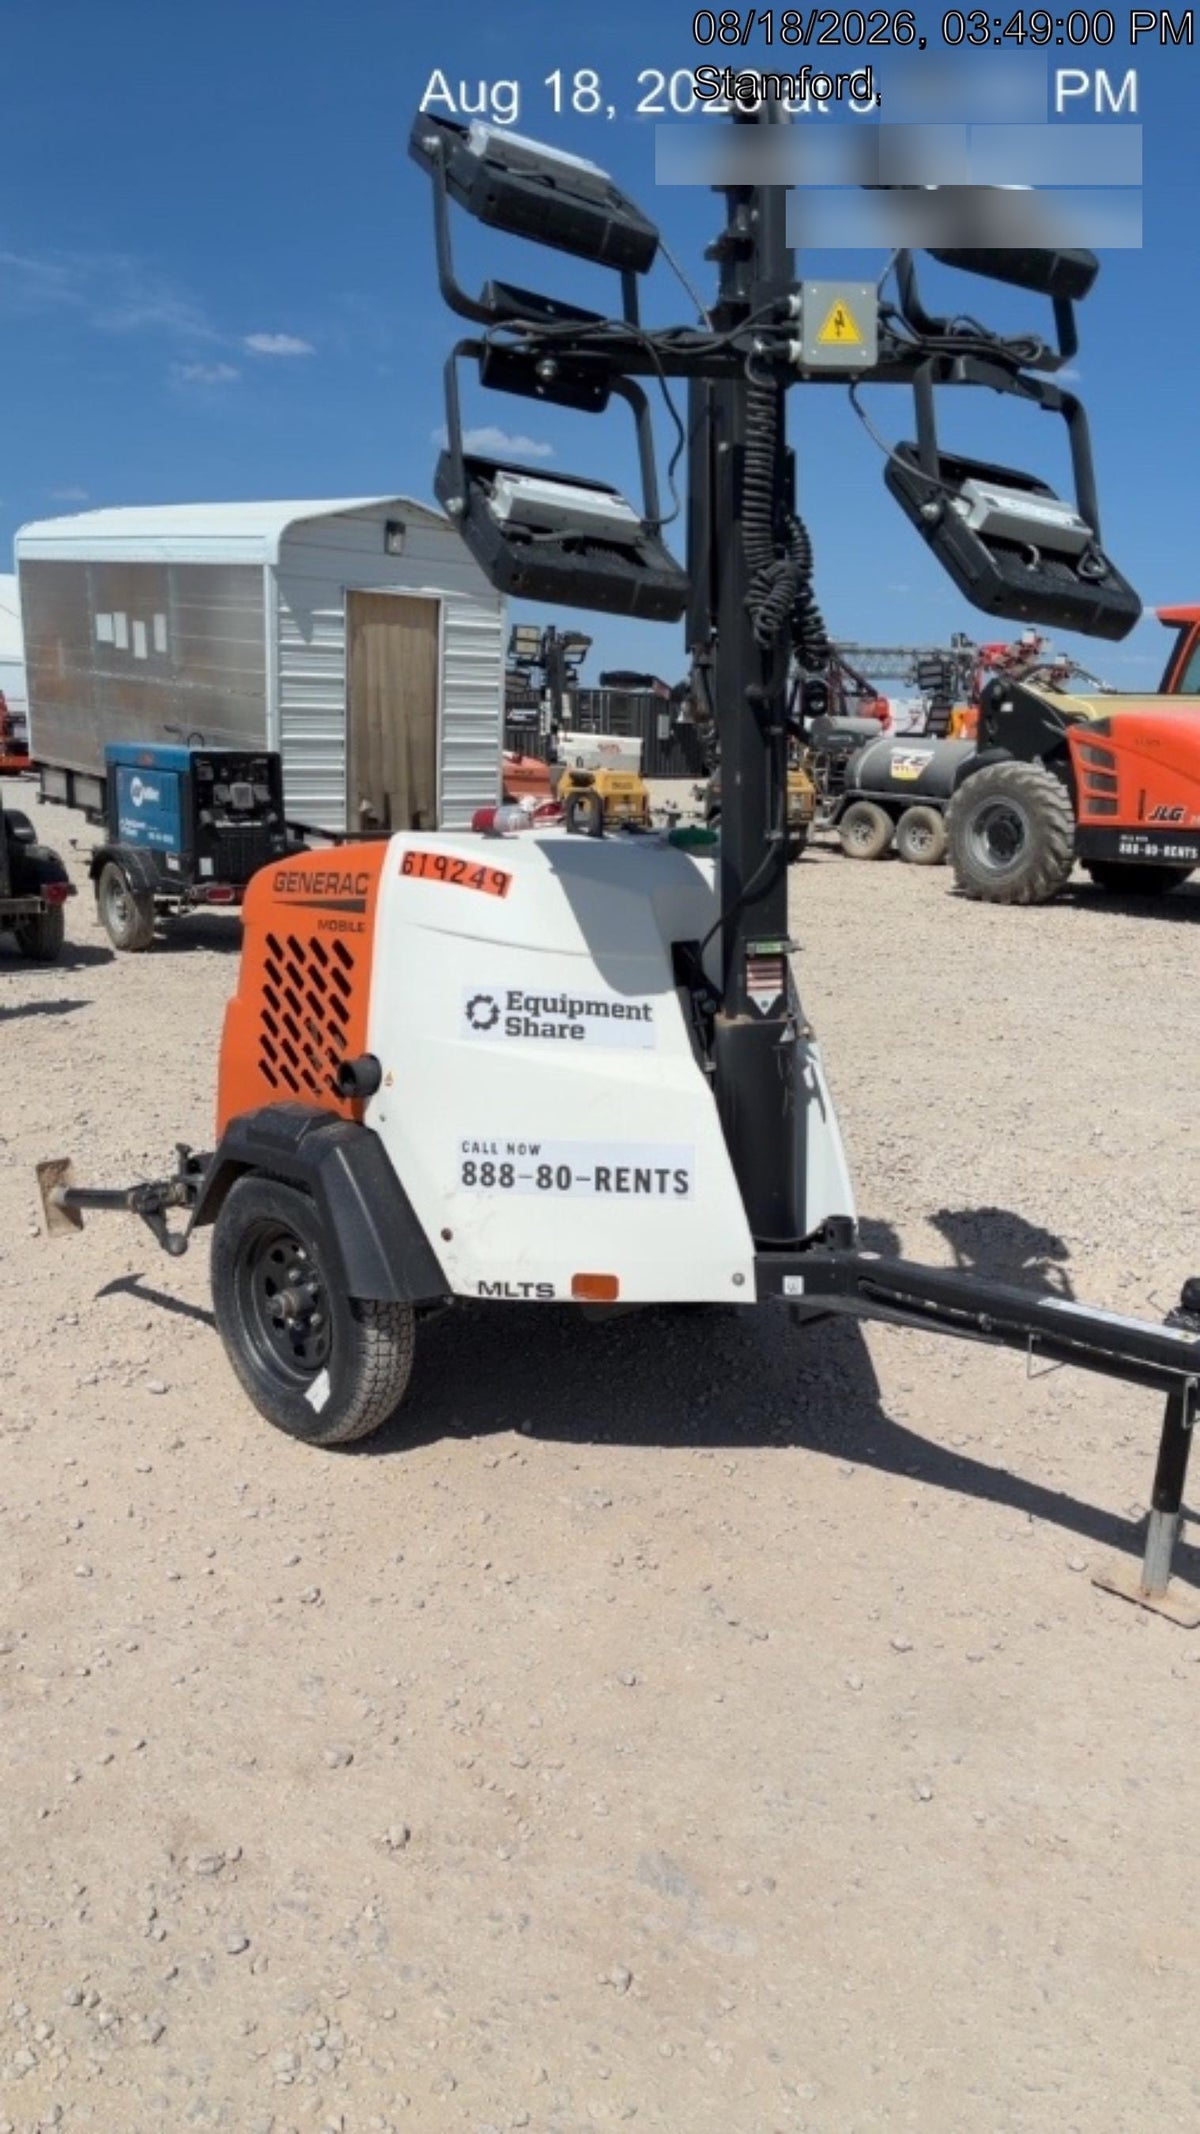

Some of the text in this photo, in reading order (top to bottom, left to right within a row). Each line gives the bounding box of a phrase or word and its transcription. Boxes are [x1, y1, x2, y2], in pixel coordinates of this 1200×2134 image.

[1147, 805, 1184, 821] JLG
[273, 871, 370, 895] GENERAC
[402, 852, 509, 896] 619249
[317, 919, 366, 932] MOBILE
[506, 990, 654, 1022] Equipment
[505, 1016, 585, 1040] Share
[462, 1140, 542, 1156] CALL NOW
[462, 1161, 689, 1195] 888-80-RENTS
[478, 1280, 556, 1298] MLTS
